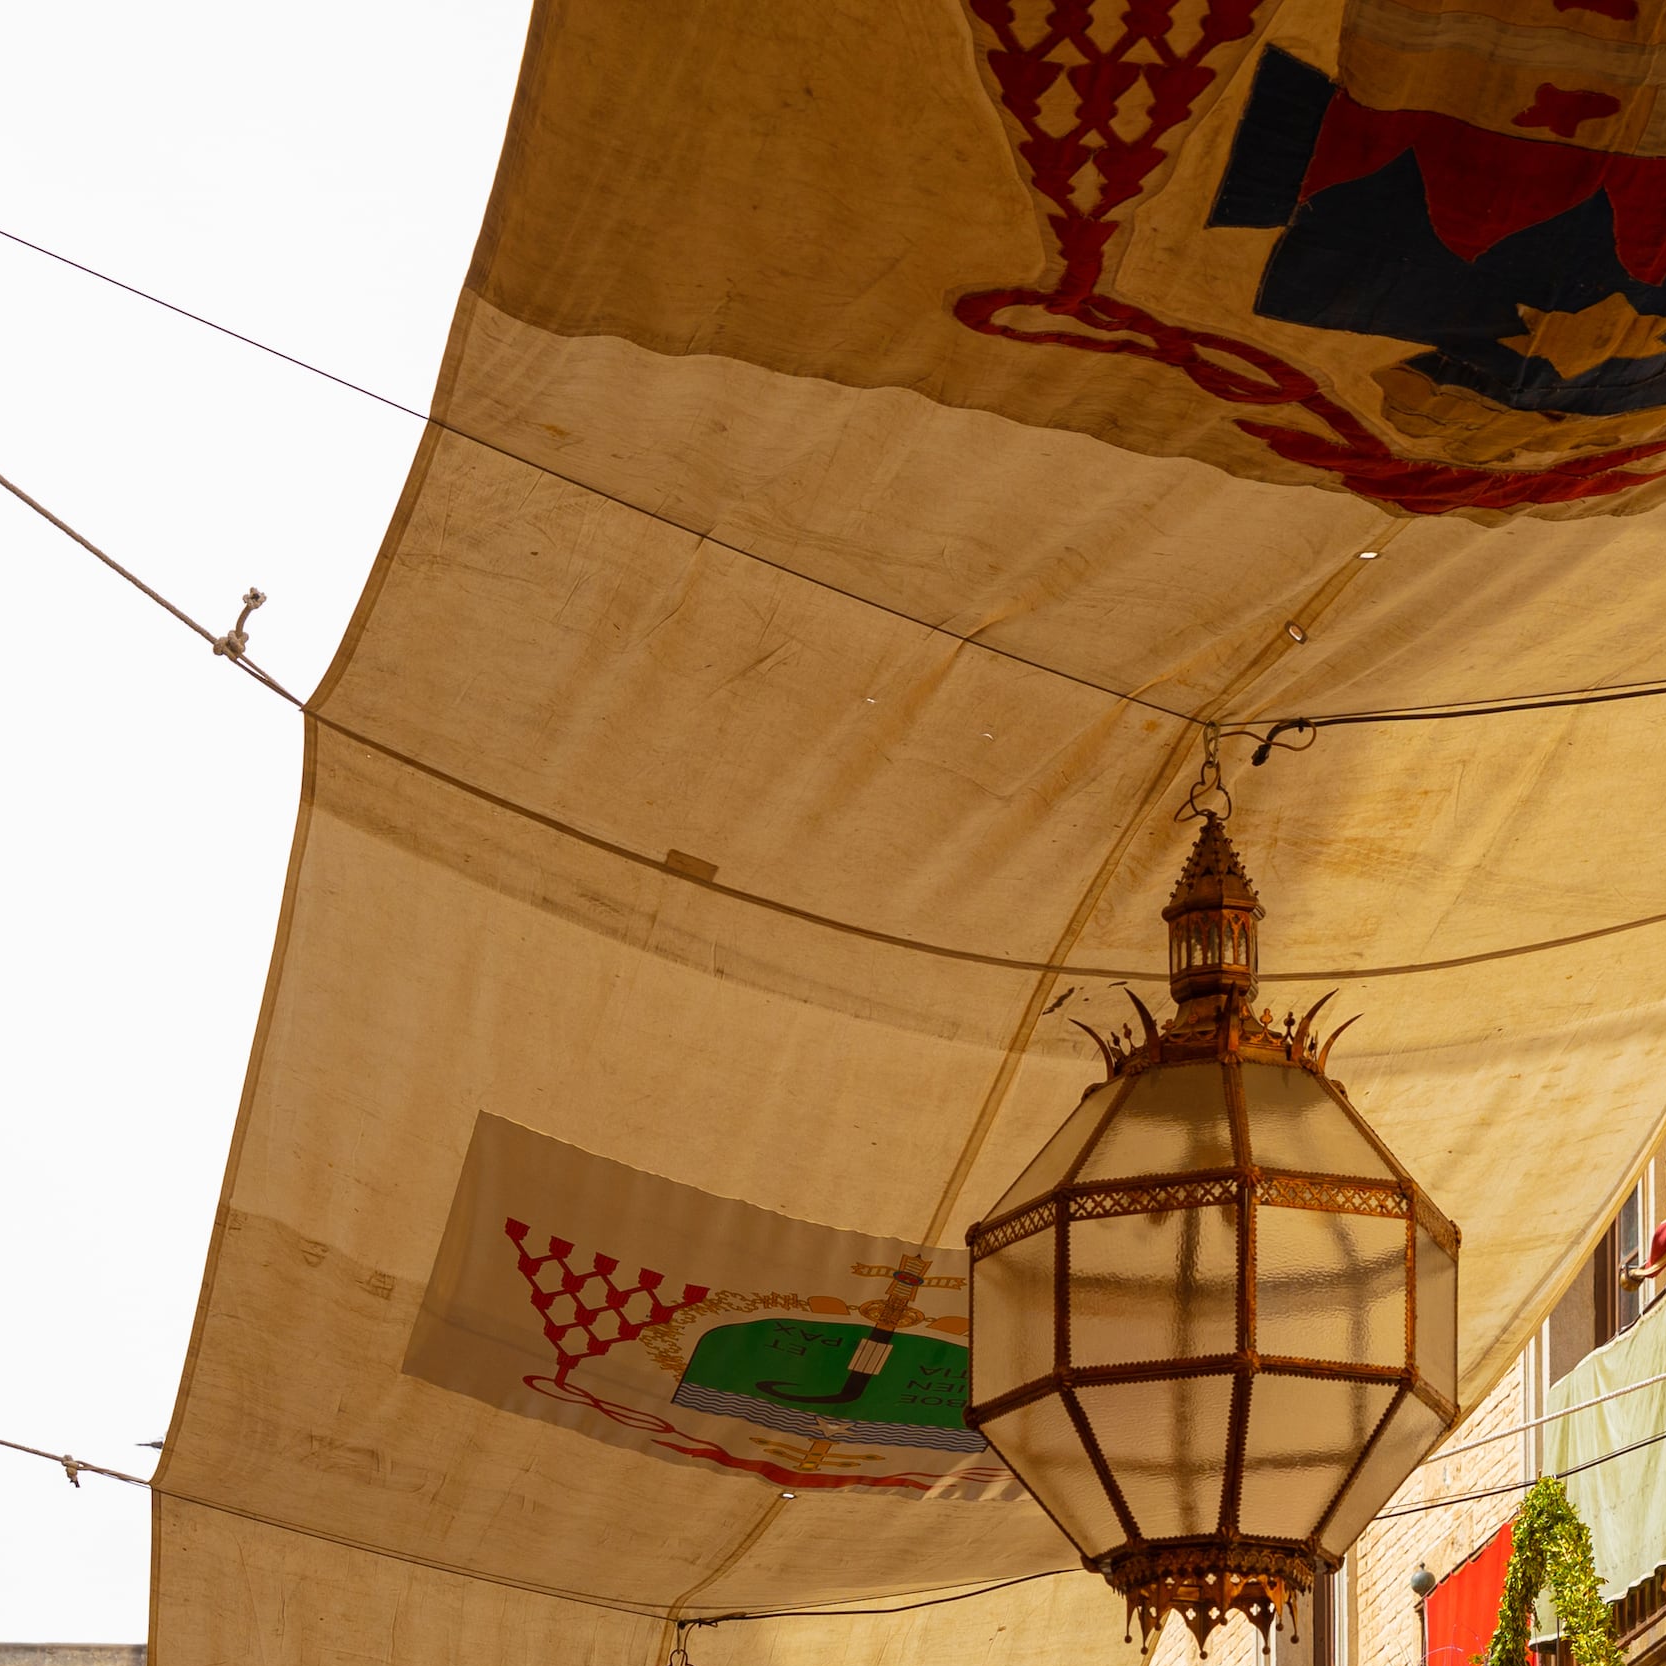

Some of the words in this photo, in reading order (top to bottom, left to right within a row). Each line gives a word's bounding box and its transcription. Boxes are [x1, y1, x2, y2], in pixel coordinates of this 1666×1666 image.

[773, 1322, 844, 1348] PAX
[764, 1338, 807, 1356] ET
[906, 1380, 966, 1394] IEN
[896, 1393, 968, 1408] BOE
